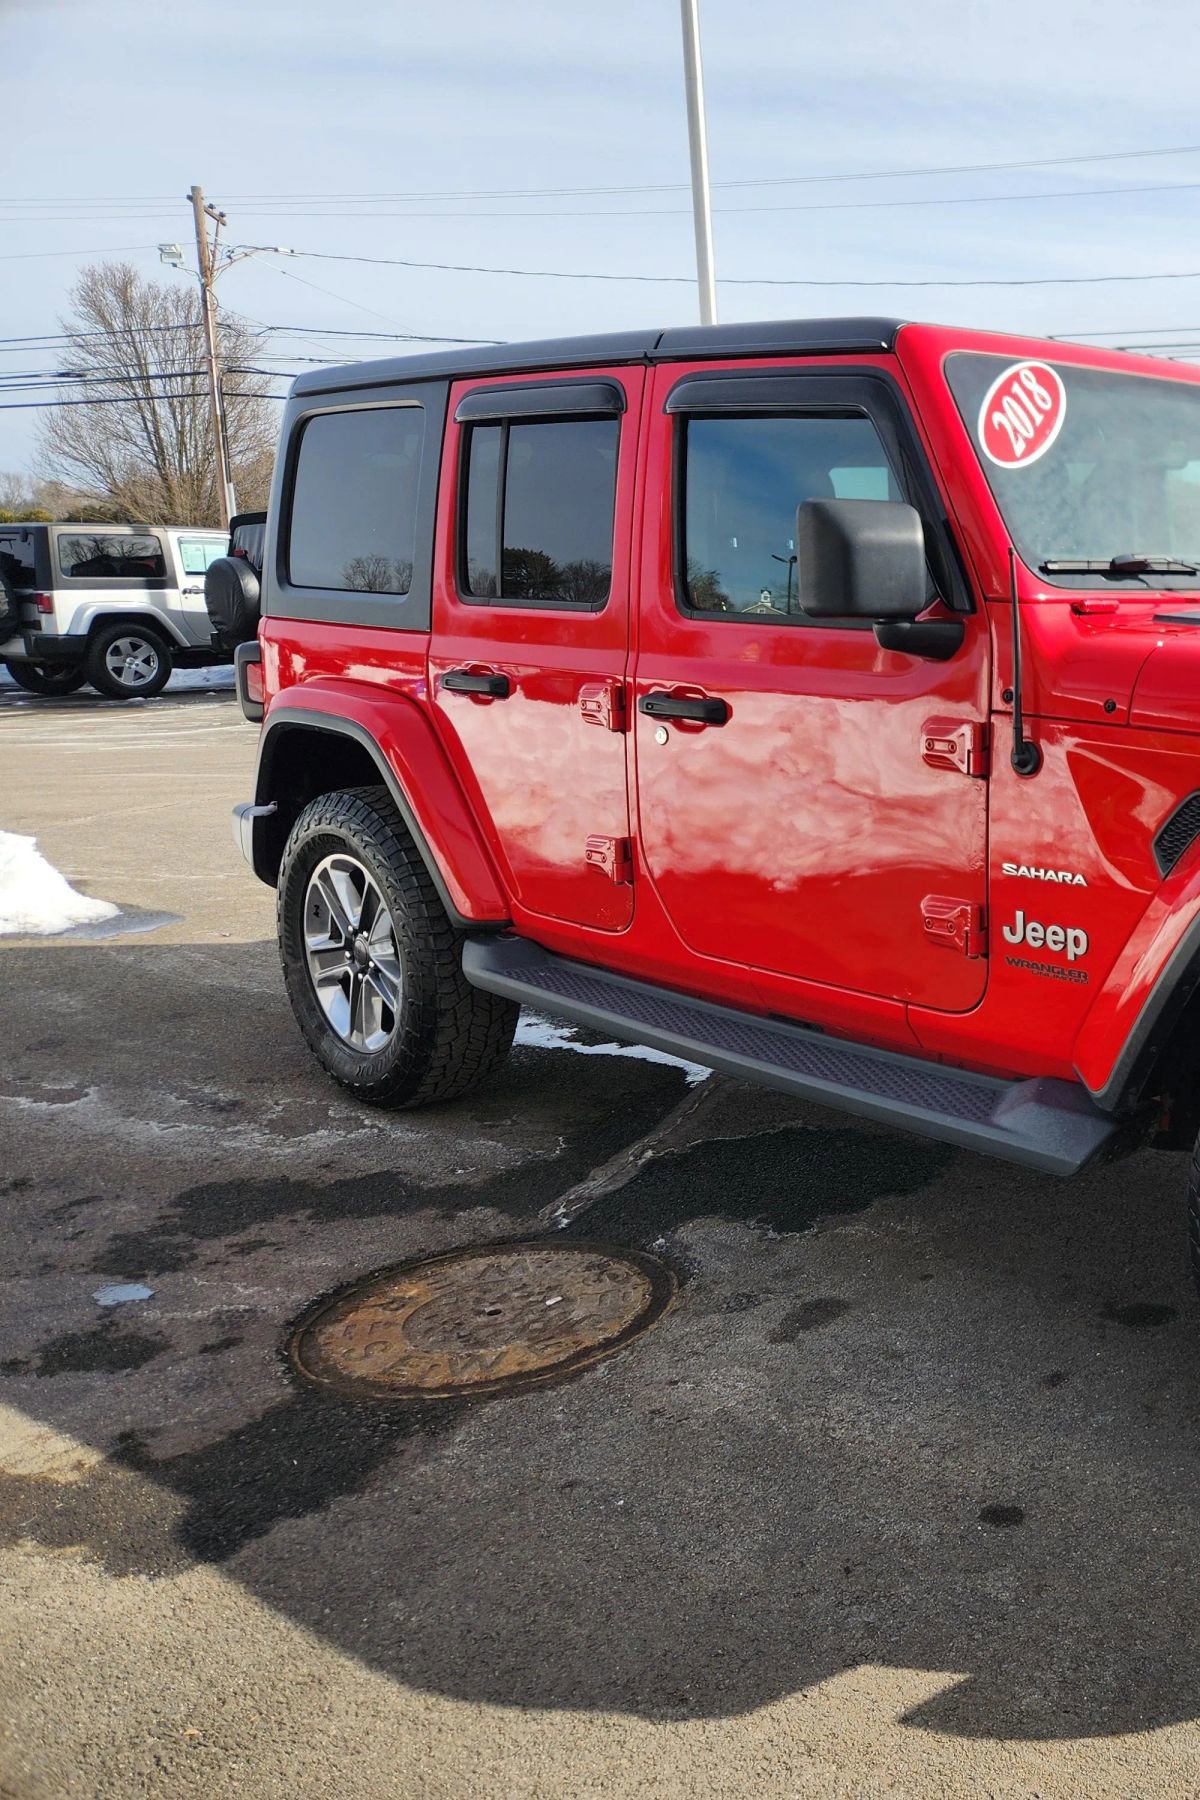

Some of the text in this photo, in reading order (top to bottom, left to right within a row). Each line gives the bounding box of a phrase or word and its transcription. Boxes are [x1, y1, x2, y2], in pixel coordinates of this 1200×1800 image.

[992, 368, 1052, 458] 2018
[1002, 863, 1088, 887] SAHARA
[1003, 910, 1088, 960] Jeep
[1006, 957, 1088, 981] WRANGLER
